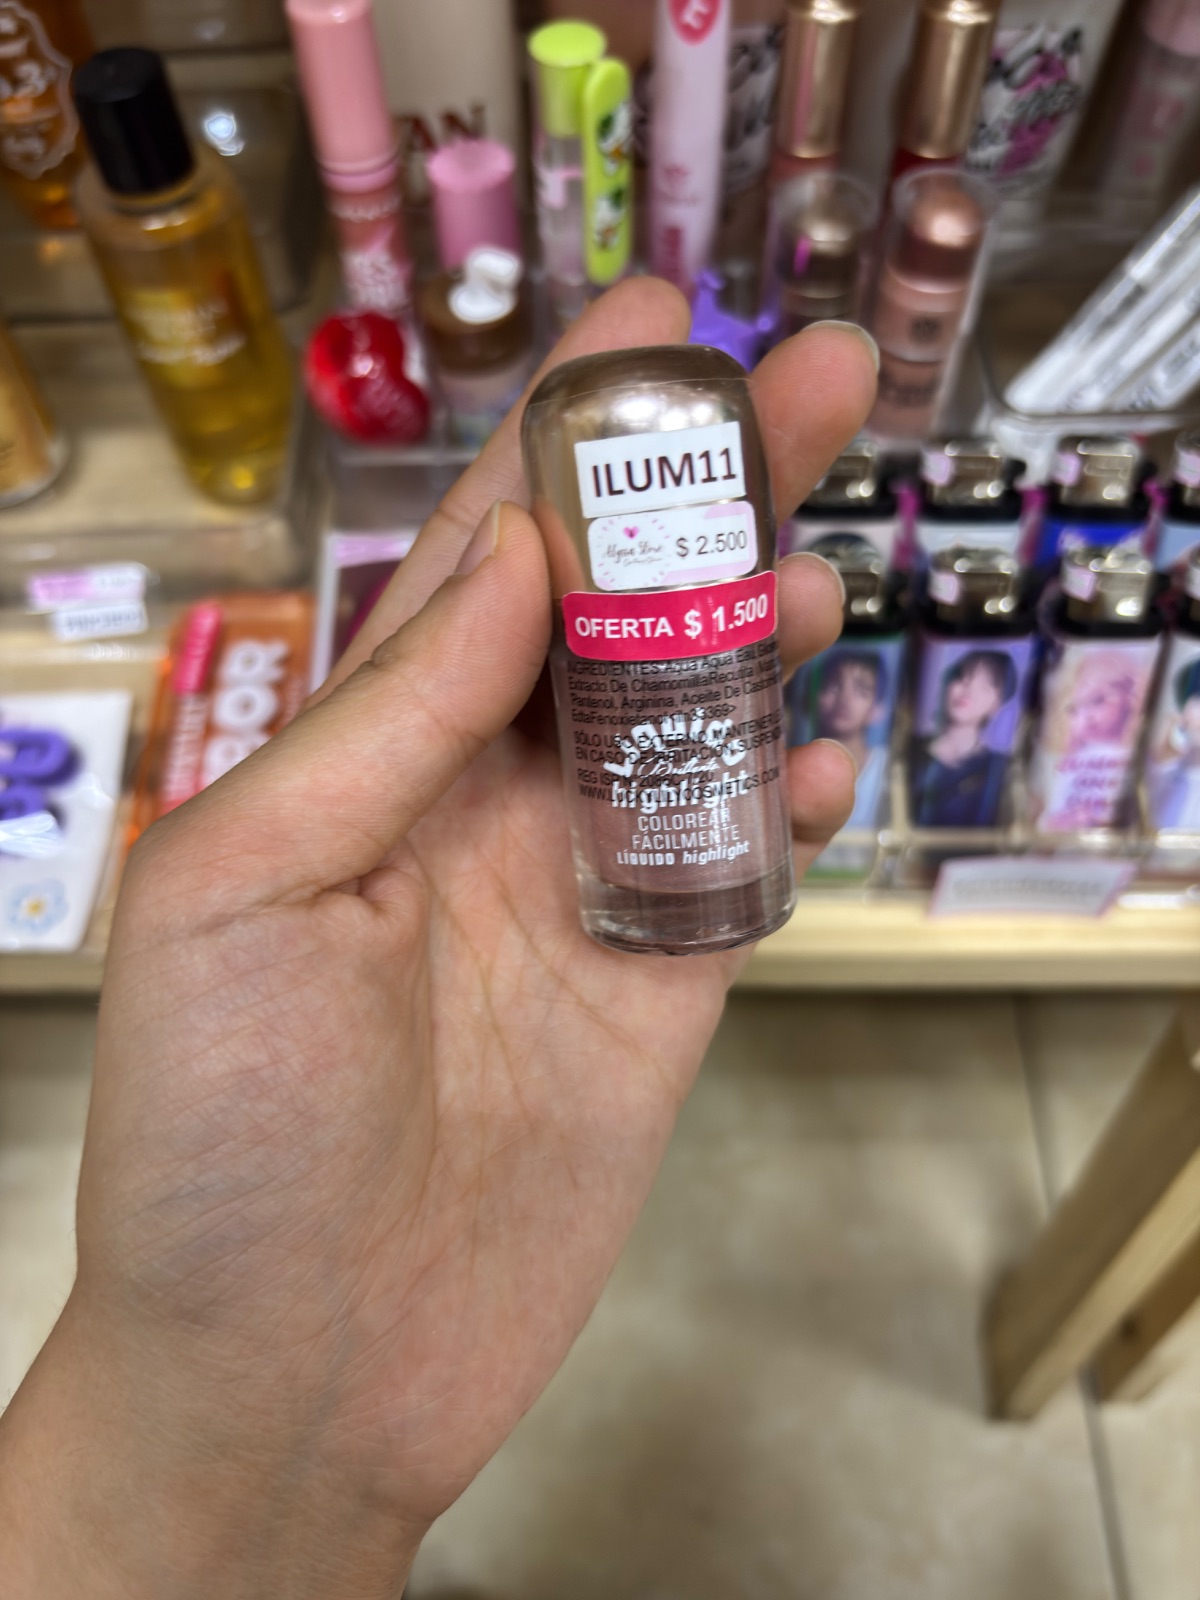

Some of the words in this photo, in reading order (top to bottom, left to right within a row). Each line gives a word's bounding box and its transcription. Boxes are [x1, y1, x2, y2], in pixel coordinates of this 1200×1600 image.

[592, 447, 737, 498] ILUM11
[676, 537, 689, 558] $
[696, 530, 748, 555] 2.500
[575, 616, 675, 640] OFERTA
[684, 609, 702, 639] $
[711, 594, 768, 634] 1.500
[611, 769, 750, 815] highlight
[637, 810, 732, 832] COLOREAR
[682, 840, 750, 866] highlight
